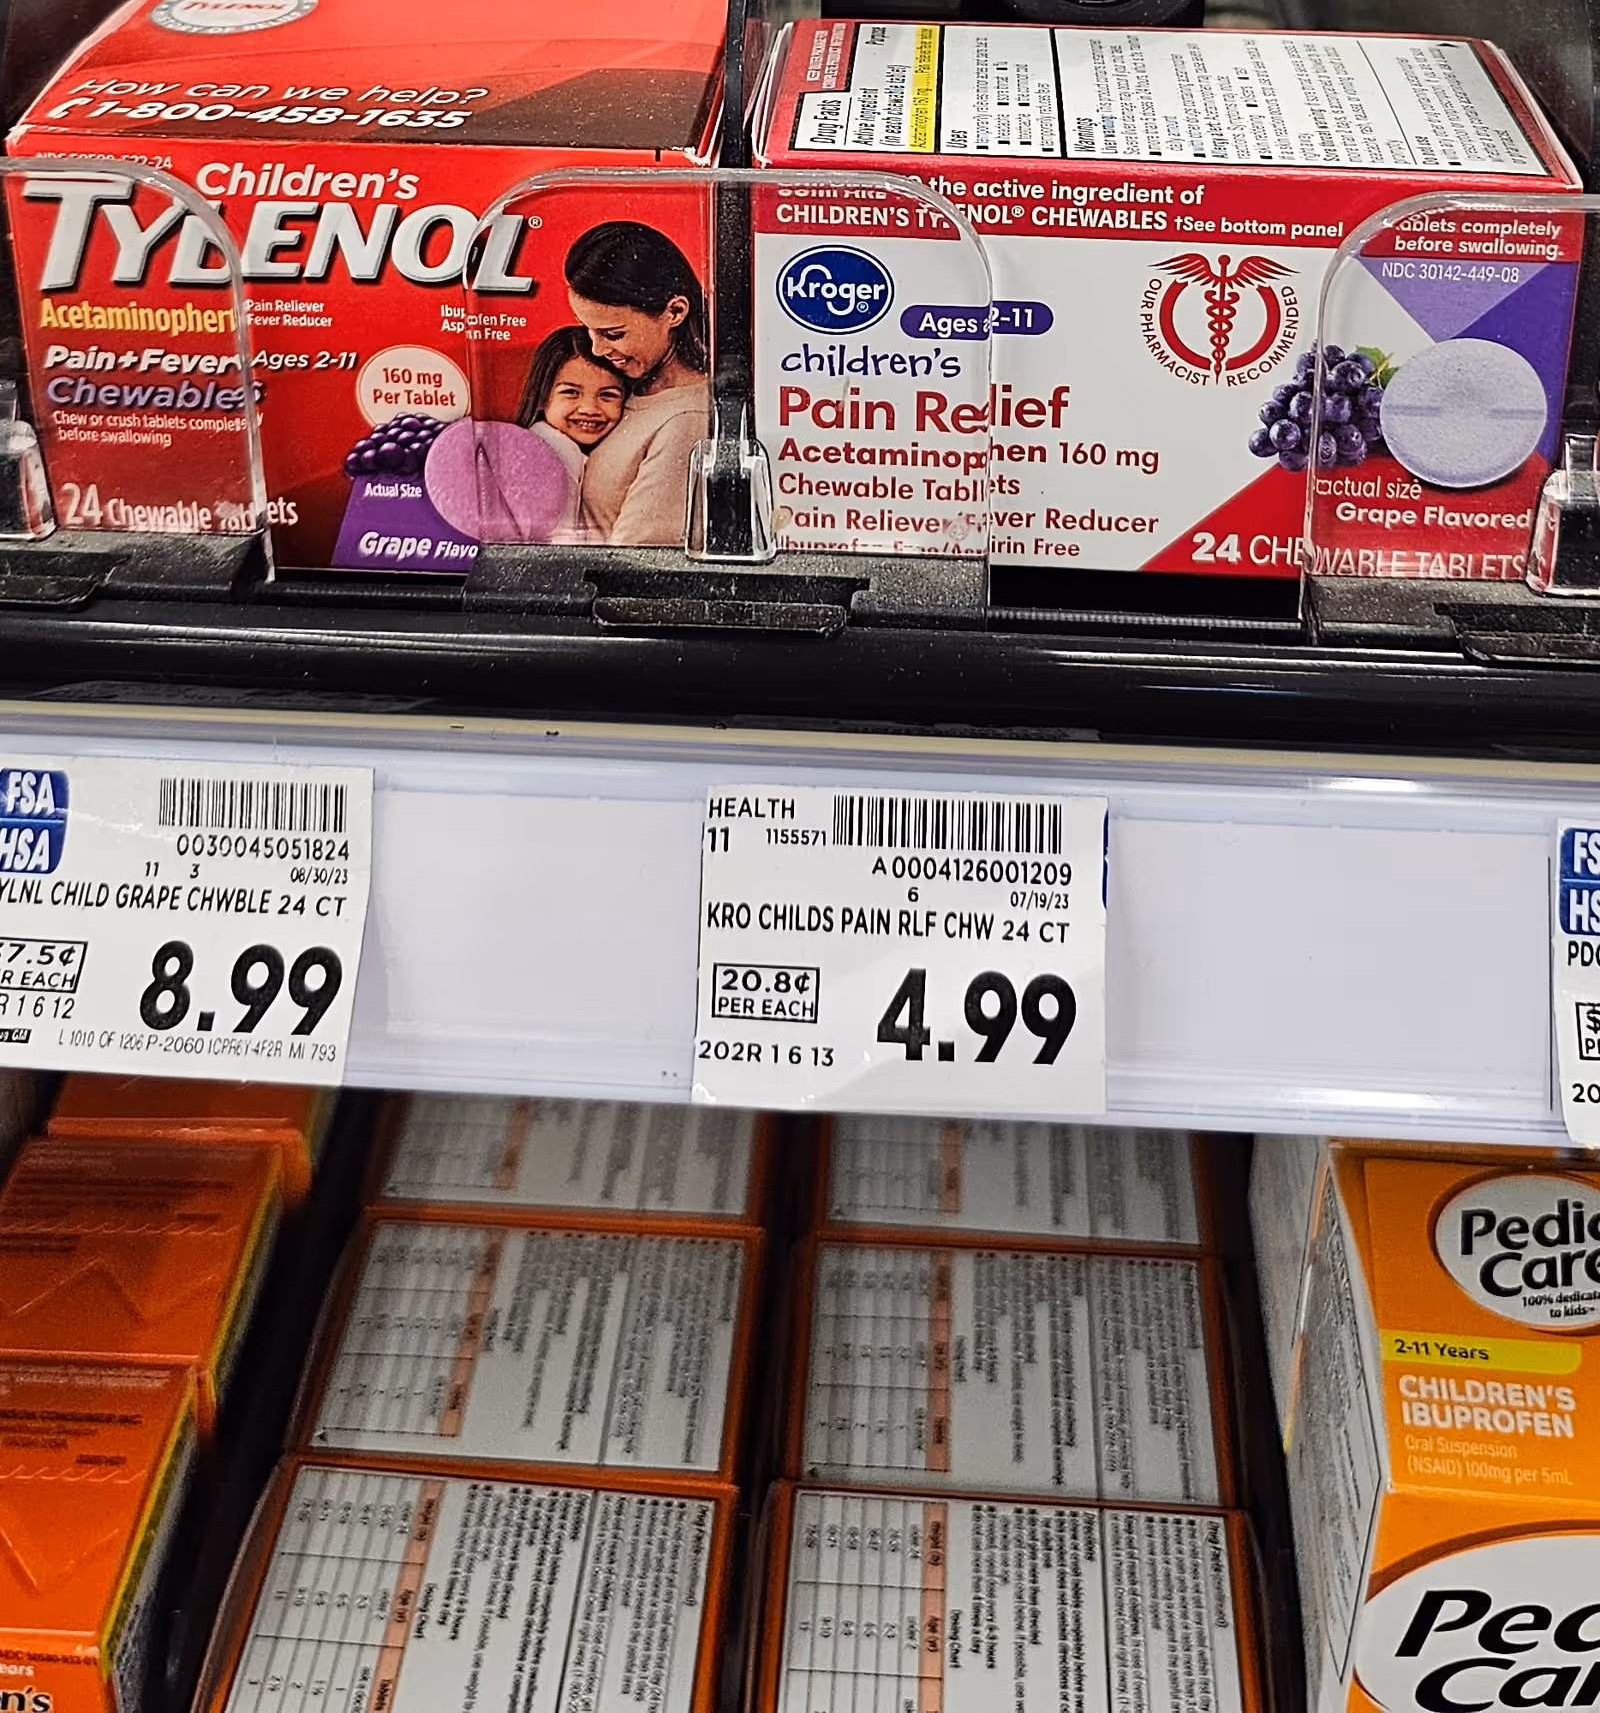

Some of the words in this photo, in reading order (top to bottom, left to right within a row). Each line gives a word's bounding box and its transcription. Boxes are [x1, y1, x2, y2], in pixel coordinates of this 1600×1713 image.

[67, 79, 181, 96] How
[187, 82, 271, 99] can
[282, 85, 350, 100] we
[356, 85, 489, 107] help?
[858, 88, 880, 122] ingredient
[87, 100, 473, 129] 1-800-458-1635
[816, 100, 841, 121] Facts
[809, 124, 839, 144] Drug
[855, 123, 876, 146] Active
[945, 130, 968, 149] Uses
[1073, 118, 1096, 152] Warnings
[198, 163, 419, 198] Children's
[929, 176, 966, 197] the
[973, 180, 1044, 199] active
[1052, 183, 1173, 206] ingredient
[1180, 184, 1202, 204] of
[777, 204, 909, 227] CHILDREN'S
[1031, 206, 1168, 230] CHEWABLES
[1221, 217, 1289, 235] bottom
[1291, 220, 1344, 240] panel
[1461, 218, 1560, 239] completely
[1395, 235, 1453, 252] before
[1458, 238, 1563, 261] swallowing.
[1382, 262, 1414, 278] NDC
[1419, 264, 1520, 282] 30142-449-08
[247, 300, 273, 312] Pain
[274, 300, 324, 313] Reliever
[1140, 279, 1162, 309] OUR
[247, 314, 281, 326] Fever
[282, 315, 333, 327] Reducer
[500, 314, 526, 326] Free
[919, 312, 978, 337] Ages
[485, 328, 511, 340] Free
[1226, 286, 1298, 386] RECOMMENDED
[45, 345, 242, 374] Pain+Fever
[251, 350, 308, 369] Ages
[315, 351, 357, 368] 2-11
[780, 343, 961, 378] children's
[1140, 313, 1210, 386] PHARMACIST
[383, 368, 411, 385] 160
[417, 371, 442, 389] mg
[373, 390, 398, 404] Per
[403, 390, 456, 406] Tablet
[780, 385, 895, 432] Pain
[916, 385, 1070, 434] Relief
[54, 410, 87, 426] Chew
[91, 414, 105, 426] or
[107, 414, 140, 427] crush
[143, 414, 187, 429] tablets
[58, 427, 99, 441] before
[101, 430, 172, 446] swallowing
[778, 438, 1047, 475] Acetaminophen
[1059, 442, 1106, 466] 160
[1116, 449, 1159, 474] mg
[364, 483, 399, 497] Actual
[400, 484, 422, 498] Size
[778, 473, 914, 500] Chewable
[1385, 478, 1422, 500] size
[61, 483, 103, 526] 24
[107, 498, 212, 533] Chewable
[1045, 508, 1159, 534] Reducer
[1336, 503, 1417, 530] Grape
[1423, 505, 1532, 529] Flavored
[359, 531, 431, 562] Grape
[1034, 537, 1080, 557] Free
[1192, 532, 1241, 563] 24
[6, 771, 56, 815] FSA
[708, 797, 795, 820] HEALTH
[0, 827, 50, 871] HSA
[177, 834, 349, 861] 0030045051824
[708, 827, 730, 853] 11
[765, 828, 827, 847] 1155571
[145, 861, 160, 878] 11
[190, 863, 200, 878] 3
[291, 867, 348, 885] 08/30/23
[872, 856, 888, 875] A
[892, 856, 1073, 886] 0004126001209
[51, 879, 109, 908] CHILD
[116, 885, 182, 910] GRAPE
[187, 886, 271, 913] CHWBLE
[278, 895, 306, 915] 24
[316, 896, 348, 917] CT
[908, 887, 919, 902] 6
[1010, 891, 1070, 910] 07/19/23
[707, 902, 751, 929] KRO
[758, 904, 834, 933] CHILDS
[841, 909, 890, 935] PAIN
[899, 910, 936, 938] RLF
[944, 912, 994, 940] CHW
[1002, 920, 1030, 942] 24
[1039, 922, 1070, 944] CT
[20, 971, 76, 988] EACH
[139, 940, 343, 1036] 8.99
[721, 969, 810, 995] 20.8¢
[18, 996, 25, 1016] 1
[32, 996, 45, 1018] 6
[52, 996, 75, 1019] 12
[717, 997, 755, 1015] PER
[761, 999, 814, 1018] EACH
[877, 967, 1077, 1065] 4.99
[70, 1031, 94, 1047] 1010
[120, 1033, 144, 1051] 1206
[146, 1036, 204, 1055] P-2060
[311, 1043, 336, 1062] 793
[699, 1040, 762, 1063] 202R
[771, 1044, 780, 1063] 1
[788, 1045, 802, 1065] 6
[812, 1046, 834, 1067] 13
[1522, 1295, 1553, 1307] 100%
[1550, 1307, 1561, 1318] to
[1395, 1339, 1429, 1356] 2-11
[1436, 1343, 1489, 1360] Years
[1399, 1375, 1575, 1411] CHILDREN'S
[1402, 1401, 1574, 1439] IBUPROFEN
[1405, 1436, 1434, 1451] Oral
[1437, 1437, 1516, 1457] Suspension
[1408, 1455, 1461, 1478] (NSAID)
[1466, 1459, 1511, 1482] 100mg
[1515, 1468, 1538, 1484] per
[947, 1609, 964, 1641] Dosing
[948, 1642, 964, 1669] Chart
